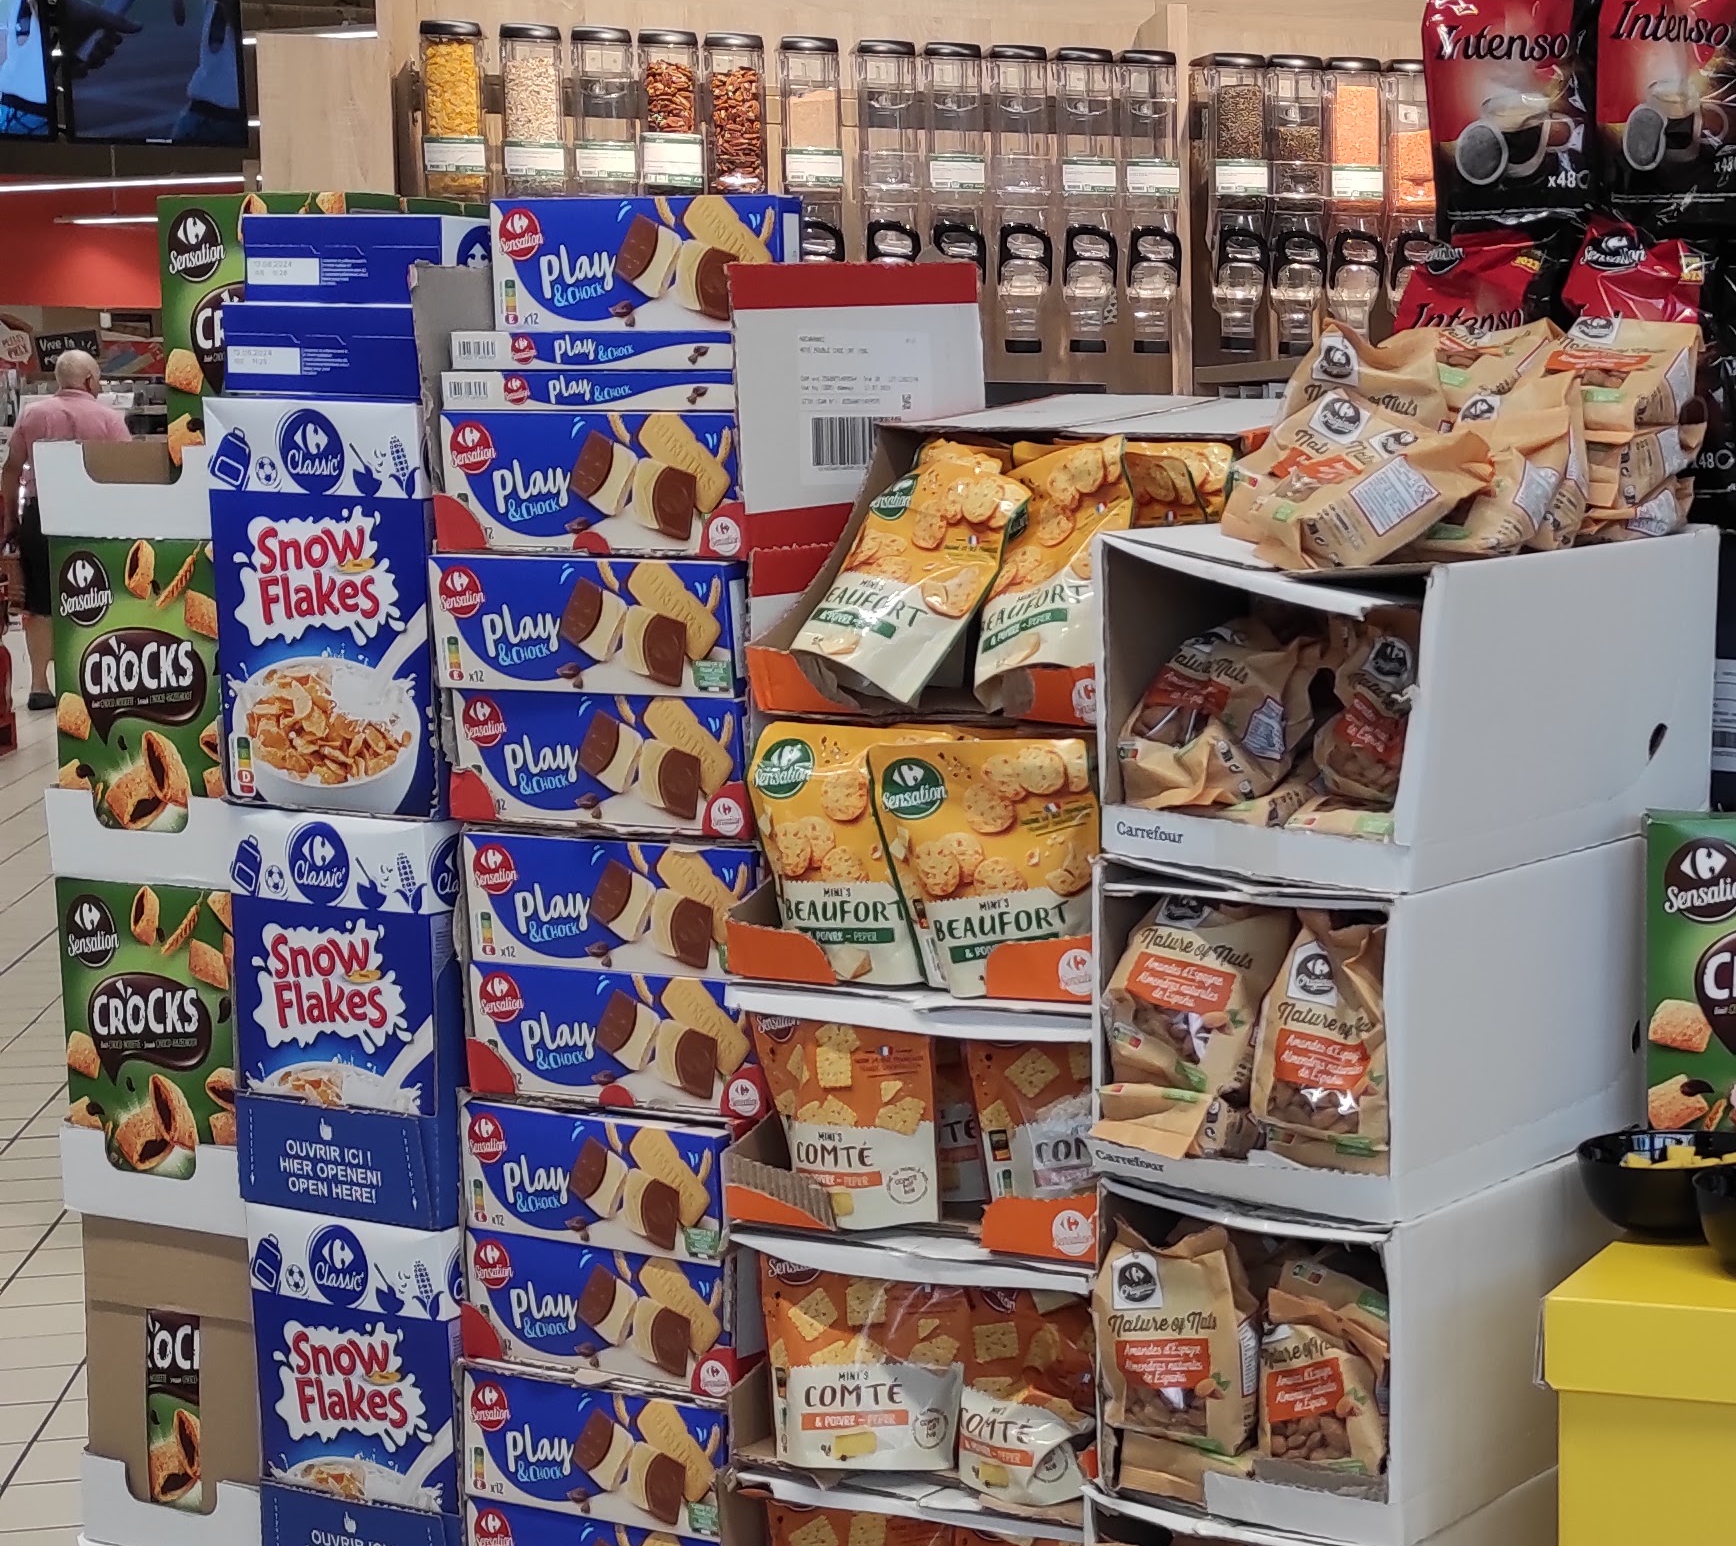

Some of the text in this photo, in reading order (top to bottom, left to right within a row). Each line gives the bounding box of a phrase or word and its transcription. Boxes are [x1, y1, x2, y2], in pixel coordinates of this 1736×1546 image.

[1612, 0, 1733, 48] Intenso
[1436, 24, 1571, 64] Intenso
[169, 244, 226, 276] Sensation
[498, 231, 544, 260] Sensation
[254, 522, 367, 578] Snow
[59, 587, 114, 616] Sensation
[259, 568, 382, 627] Flakes
[84, 638, 195, 696] CROCKS
[880, 782, 947, 809] Sensation
[1115, 819, 1185, 845] Carrefour
[932, 900, 1071, 944] BEAUFORT
[269, 928, 372, 983] Snow
[92, 985, 200, 1036] CROCKS
[275, 976, 389, 1032] Flakes
[278, 1156, 315, 1175] HIER
[285, 1140, 368, 1166] OUVRIR ICI
[288, 1177, 377, 1205] OPEN HERE!
[1107, 1310, 1168, 1338] Nature
[803, 1377, 903, 1409] COMTÉ
